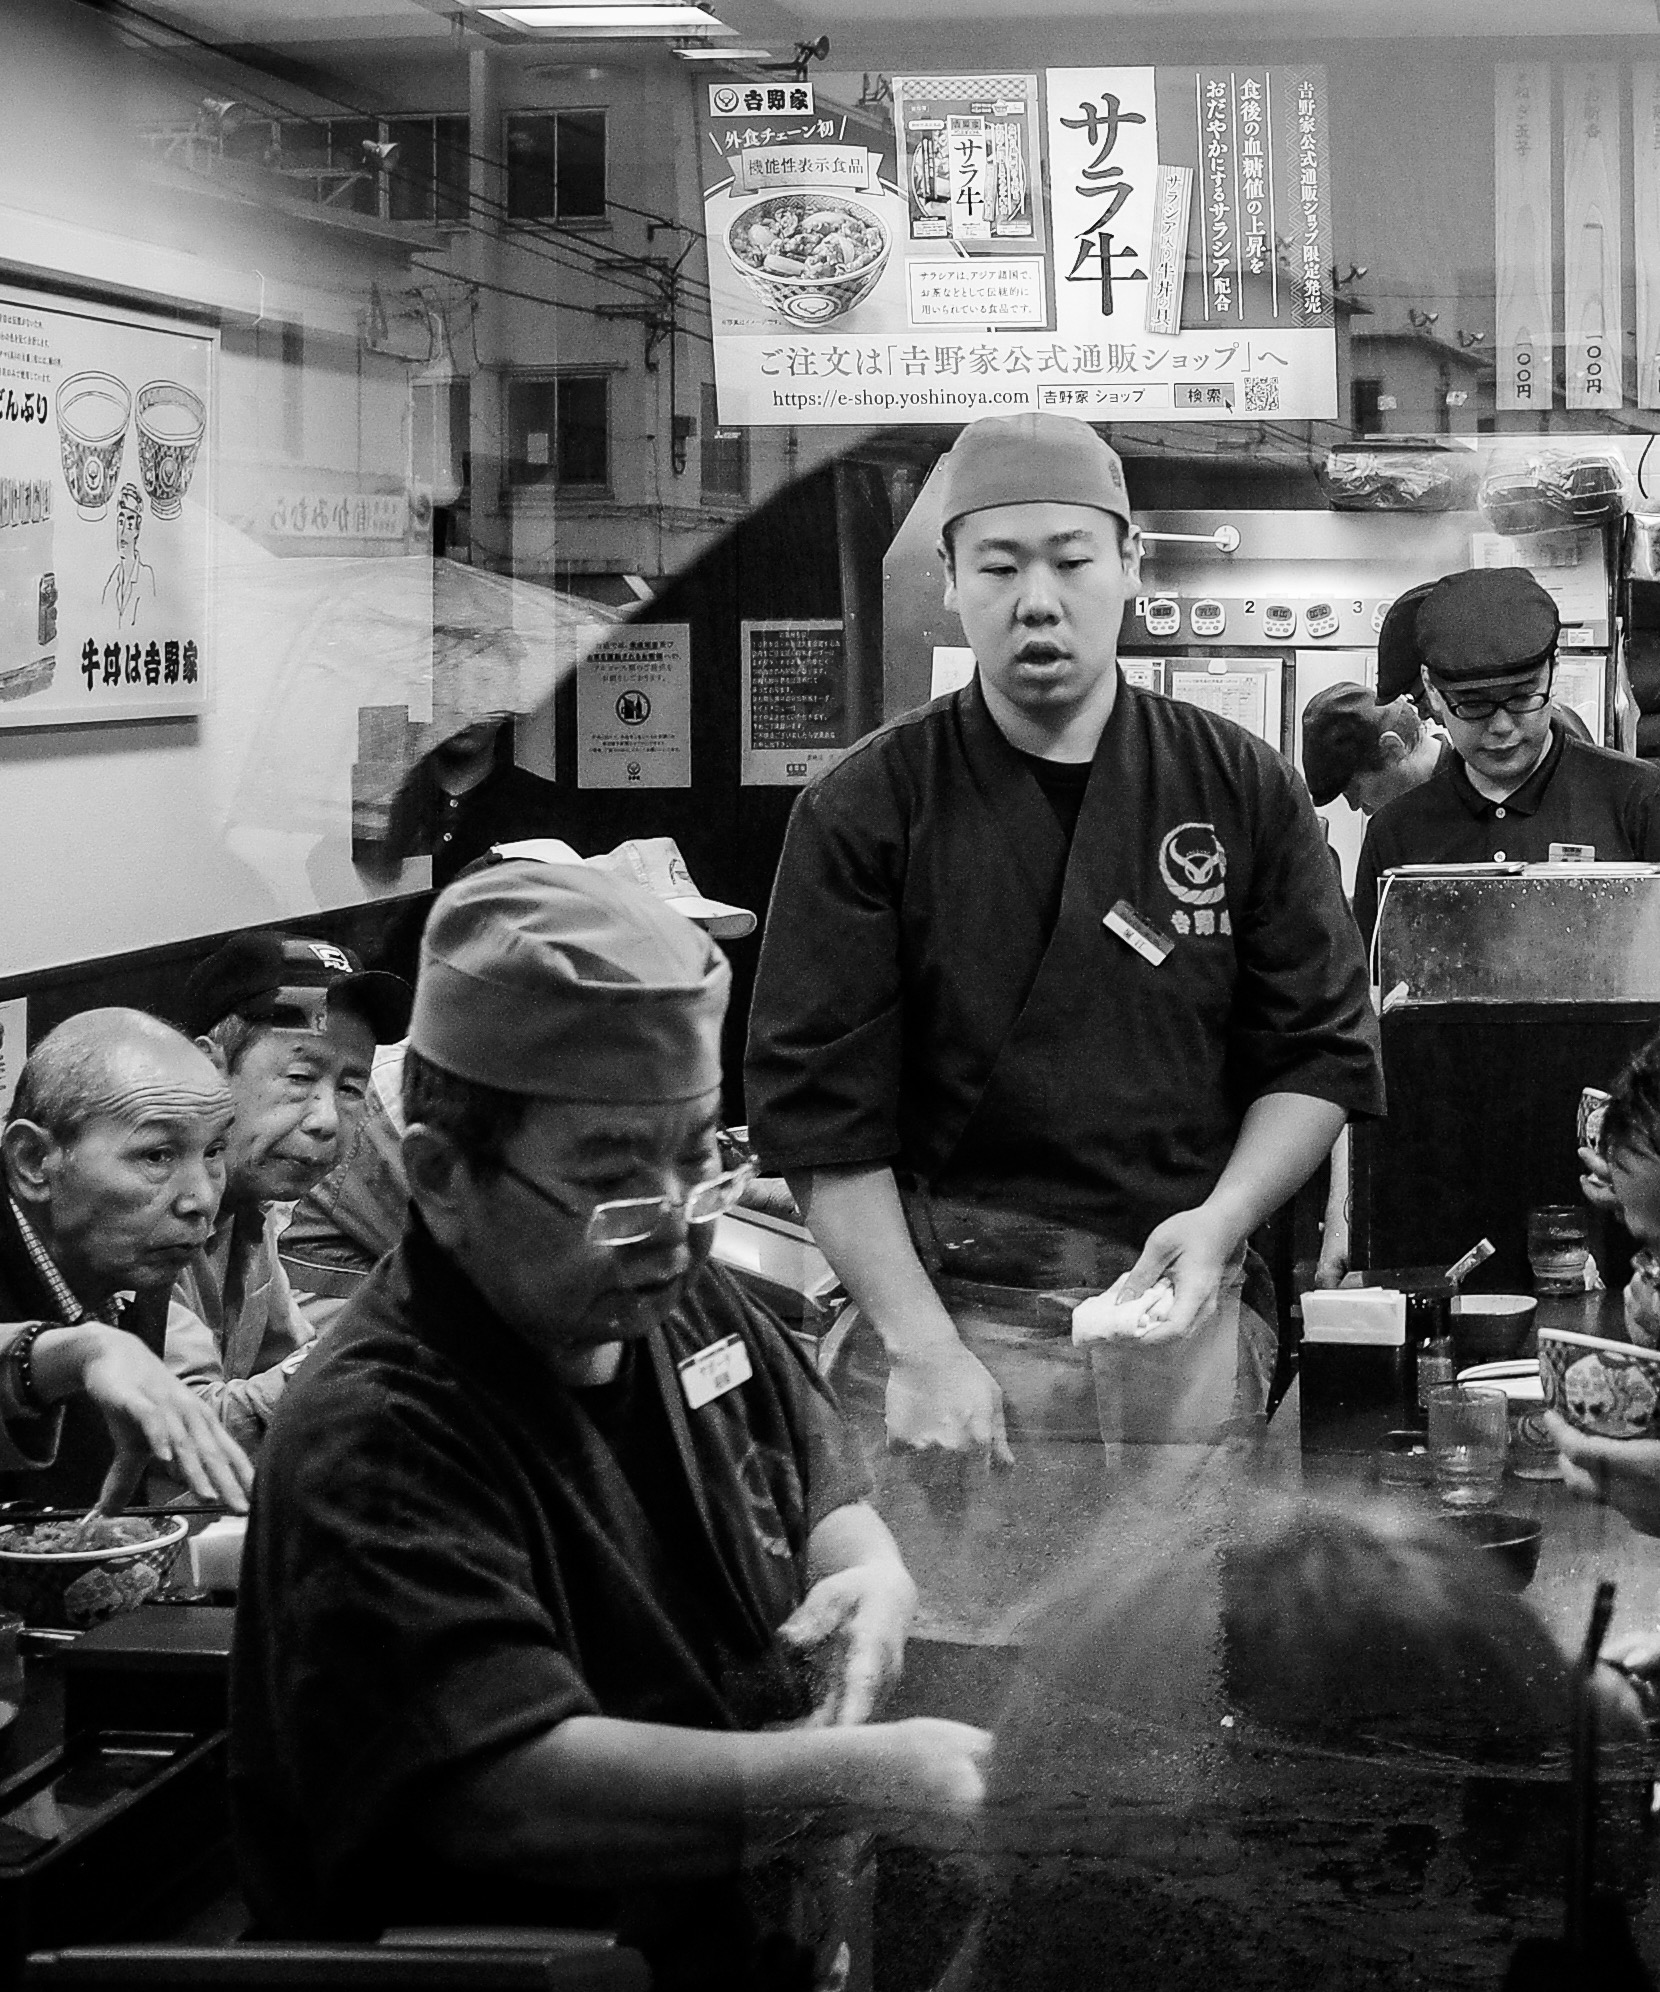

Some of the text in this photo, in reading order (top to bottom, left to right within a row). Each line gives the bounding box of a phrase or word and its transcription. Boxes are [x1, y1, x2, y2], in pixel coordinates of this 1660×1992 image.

[725, 119, 834, 150] 外食チェーン初
[748, 157, 865, 177] 機能性表示食品
[1239, 78, 1267, 276] 食後の血糖値の上昇を
[954, 139, 985, 216] サラ牛
[1060, 92, 1148, 316] サラ牛
[1206, 80, 1232, 313] おだやかにするサラシア配合
[773, 389, 1030, 410] https://e-shop.yoshinoya.com
[1095, 388, 1146, 404] ショップ
[1187, 388, 1222, 404] 検索
[1138, 600, 1146, 614] 1
[1245, 600, 1255, 614] 2
[1353, 600, 1363, 614] 3
